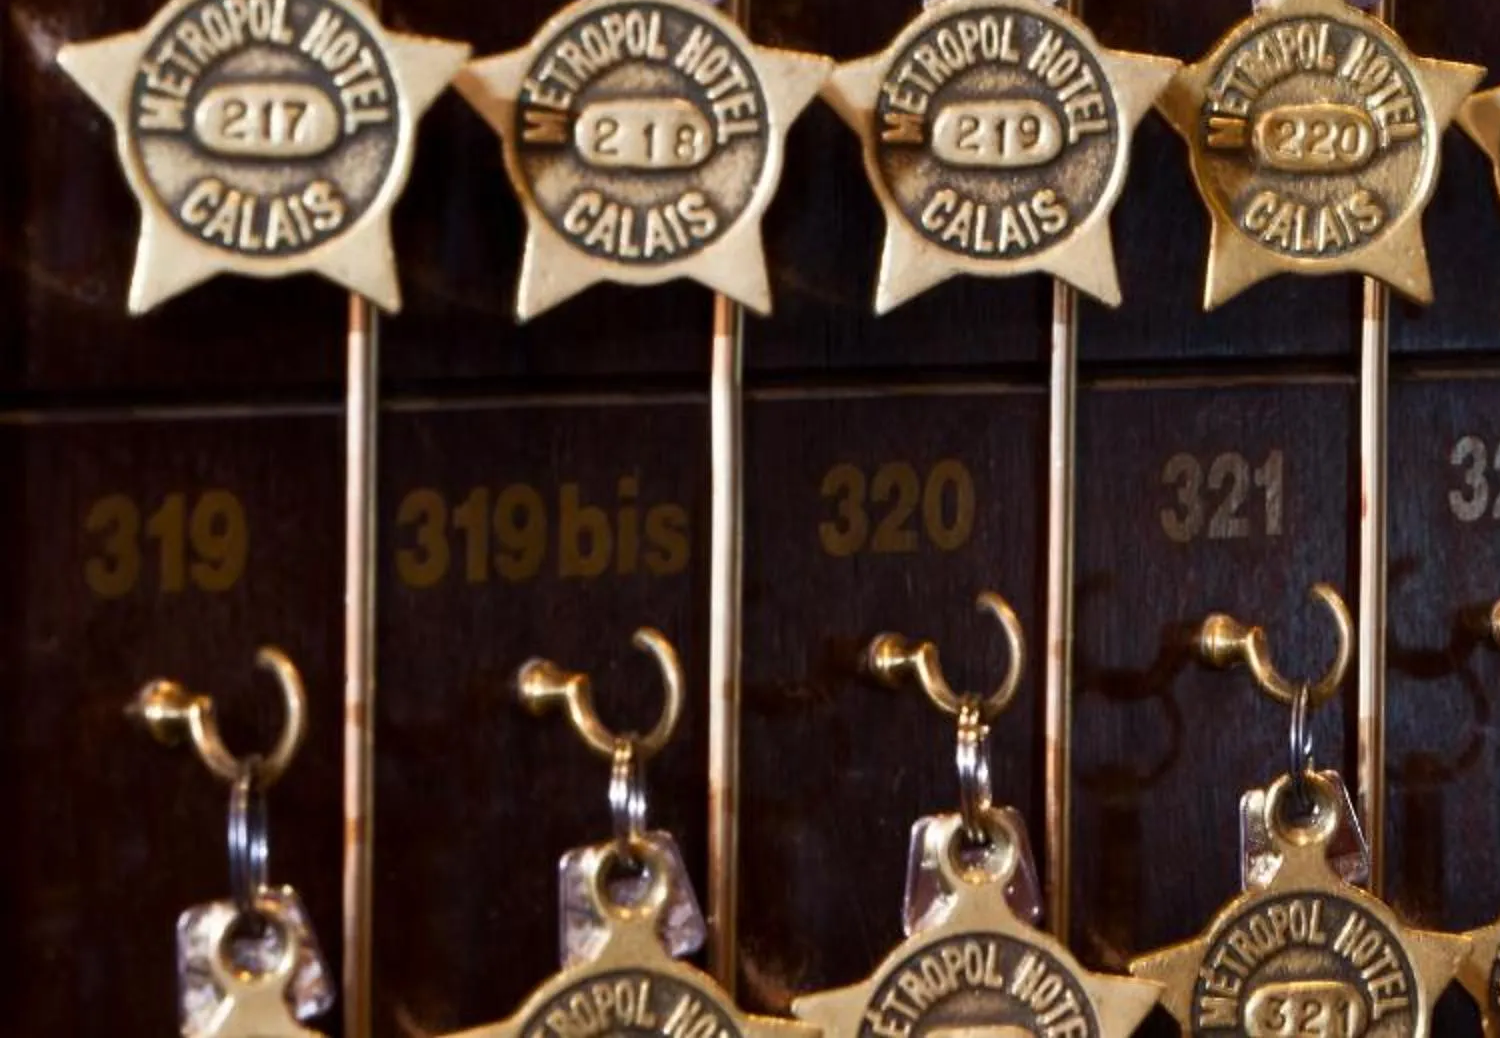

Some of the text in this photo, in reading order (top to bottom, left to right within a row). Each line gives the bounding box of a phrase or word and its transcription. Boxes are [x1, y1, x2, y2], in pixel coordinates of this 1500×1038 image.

[301, 8, 390, 134] HOTEL
[675, 25, 760, 145] HOTEL
[1027, 28, 1109, 144] HOTEL
[1341, 35, 1418, 147] HOTEL
[222, 99, 307, 141] 217
[593, 117, 696, 161] 218
[958, 116, 1040, 156] 219
[1278, 120, 1368, 160] 220
[181, 179, 345, 250] CALAIS
[563, 190, 718, 258] CALAIS
[921, 188, 1069, 253] CALAIS
[1244, 189, 1382, 251] CALAIS
[821, 459, 976, 556] 320
[1160, 449, 1282, 542] 321
[85, 489, 249, 599] 319
[1010, 951, 1088, 1038] HOTE
[1333, 910, 1409, 1021] HOTEL
[1261, 996, 1353, 1037] 321
